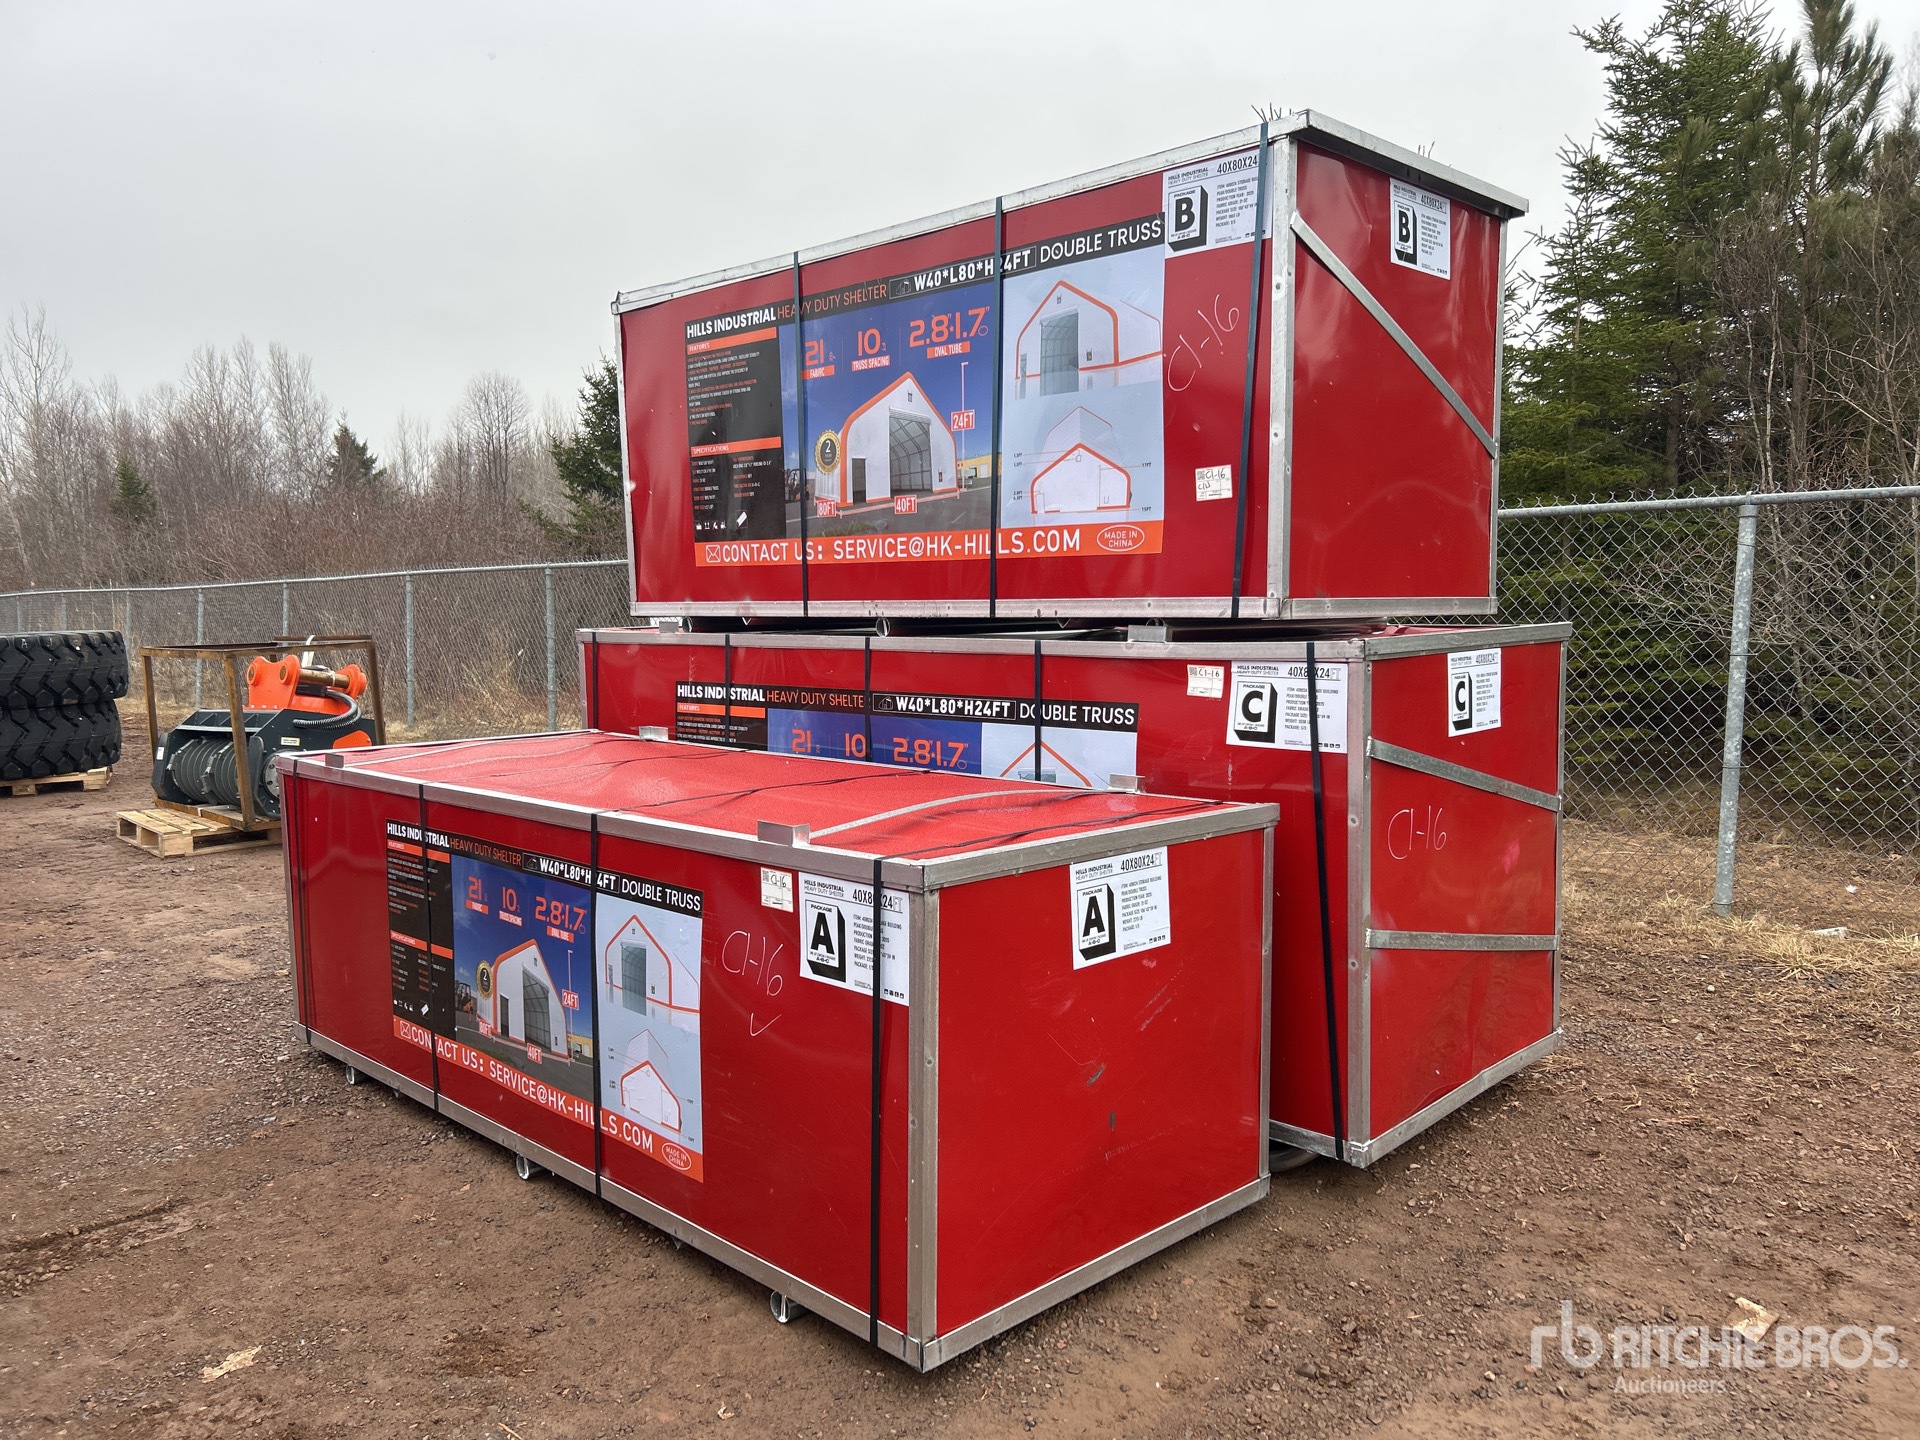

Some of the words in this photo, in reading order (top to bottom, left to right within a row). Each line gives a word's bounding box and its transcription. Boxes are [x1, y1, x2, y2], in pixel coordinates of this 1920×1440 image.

[1181, 167, 1209, 178] INDUSTRIAL
[1174, 196, 1196, 233] B
[1398, 210, 1411, 244] B
[1040, 233, 1103, 264] DOUBLE
[1107, 219, 1162, 248] TRUSS
[686, 321, 713, 339] HILLS
[714, 307, 776, 333] INDUSTRIAL
[814, 294, 842, 313] DUTY
[843, 284, 887, 305] SHELTER
[804, 338, 825, 367] 21
[857, 327, 881, 357] 10
[934, 345, 948, 358] OVAL
[948, 343, 963, 355] TUBE
[852, 359, 868, 372] TRUSS
[868, 355, 890, 368] SPACING
[953, 411, 975, 430] 24FT
[693, 444, 730, 455] SPECIFICATIONS
[825, 440, 831, 453] 2
[818, 501, 836, 517] 80FT
[895, 496, 917, 513] 40FT
[722, 542, 789, 562] CONTACT
[833, 528, 1081, 560] SERVICE@HK-HILLS.COM
[1104, 531, 1127, 540] MADE
[1128, 530, 1138, 538] IN
[1108, 538, 1134, 548] CHINA
[1198, 668, 1220, 678] C1-16
[677, 684, 703, 699] HILLS
[766, 690, 799, 704] HEAVY
[800, 691, 827, 706] DUTY
[829, 693, 866, 708] SHELTE
[1241, 689, 1264, 723] C
[1455, 680, 1466, 712] C
[1082, 706, 1135, 725] TRUSS
[791, 728, 812, 754] 21
[844, 732, 867, 758] 10
[1387, 805, 1447, 860] C1-16
[387, 822, 407, 838] HILLS
[449, 837, 474, 853] HEAVY
[474, 843, 492, 858] DUTY
[492, 847, 522, 866] SHELTER
[539, 857, 617, 891] W40L80H4FT
[1075, 873, 1088, 881] HEAVY
[1088, 871, 1099, 879] DUTY
[1099, 868, 1113, 876] SHELTER
[1088, 862, 1113, 873] INDUSTRIAL
[468, 876, 482, 901] 21
[621, 878, 662, 902] DOUBLE
[664, 888, 701, 912] TRUSS
[803, 879, 817, 887] HILLS
[817, 881, 844, 893] INDUSTRIAL
[804, 885, 817, 893] HEAVY
[817, 888, 828, 896] DUTY
[828, 890, 844, 899] SHELTER
[1082, 887, 1103, 897] PACKAGE
[502, 886, 517, 912] 10
[810, 903, 833, 913] PACKAGE
[1082, 895, 1106, 938] A
[810, 911, 835, 956] A
[721, 930, 784, 997] C1-16
[482, 969, 488, 981] 2
[562, 991, 579, 1009] 24FT
[461, 1047, 484, 1073] US:
[665, 1145, 681, 1158] MADE
[680, 1153, 688, 1162] IN
[668, 1154, 685, 1168] CHINA
